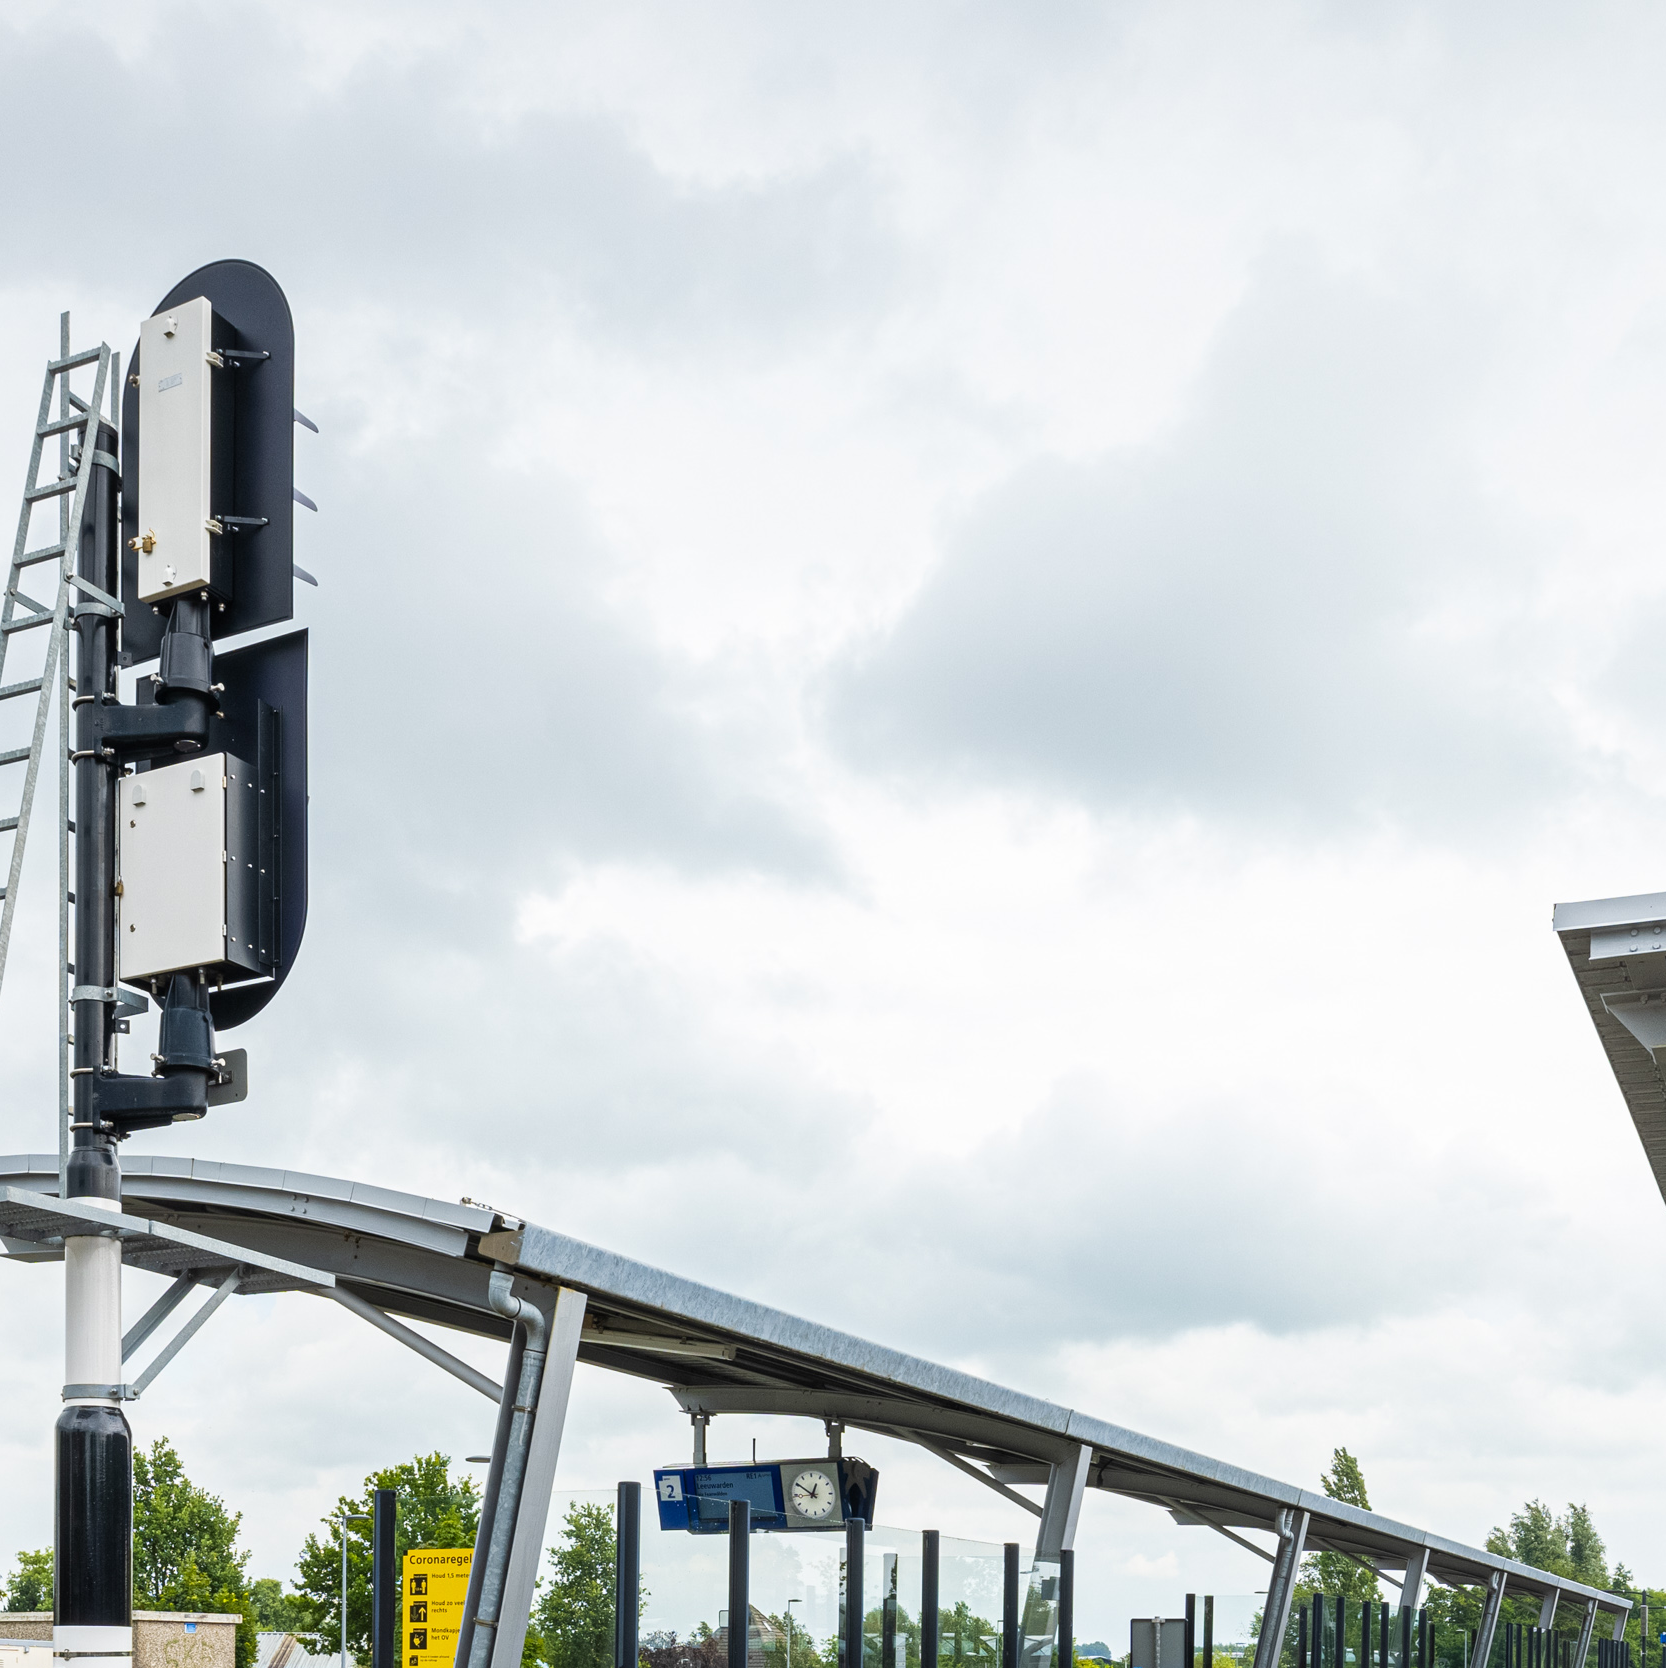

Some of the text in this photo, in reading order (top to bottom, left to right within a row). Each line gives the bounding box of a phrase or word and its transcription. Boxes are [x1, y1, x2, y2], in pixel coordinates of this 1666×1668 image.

[696, 1474, 712, 1482] 12:56
[666, 1485, 676, 1498] 2
[410, 1553, 472, 1566] Coronaregel
